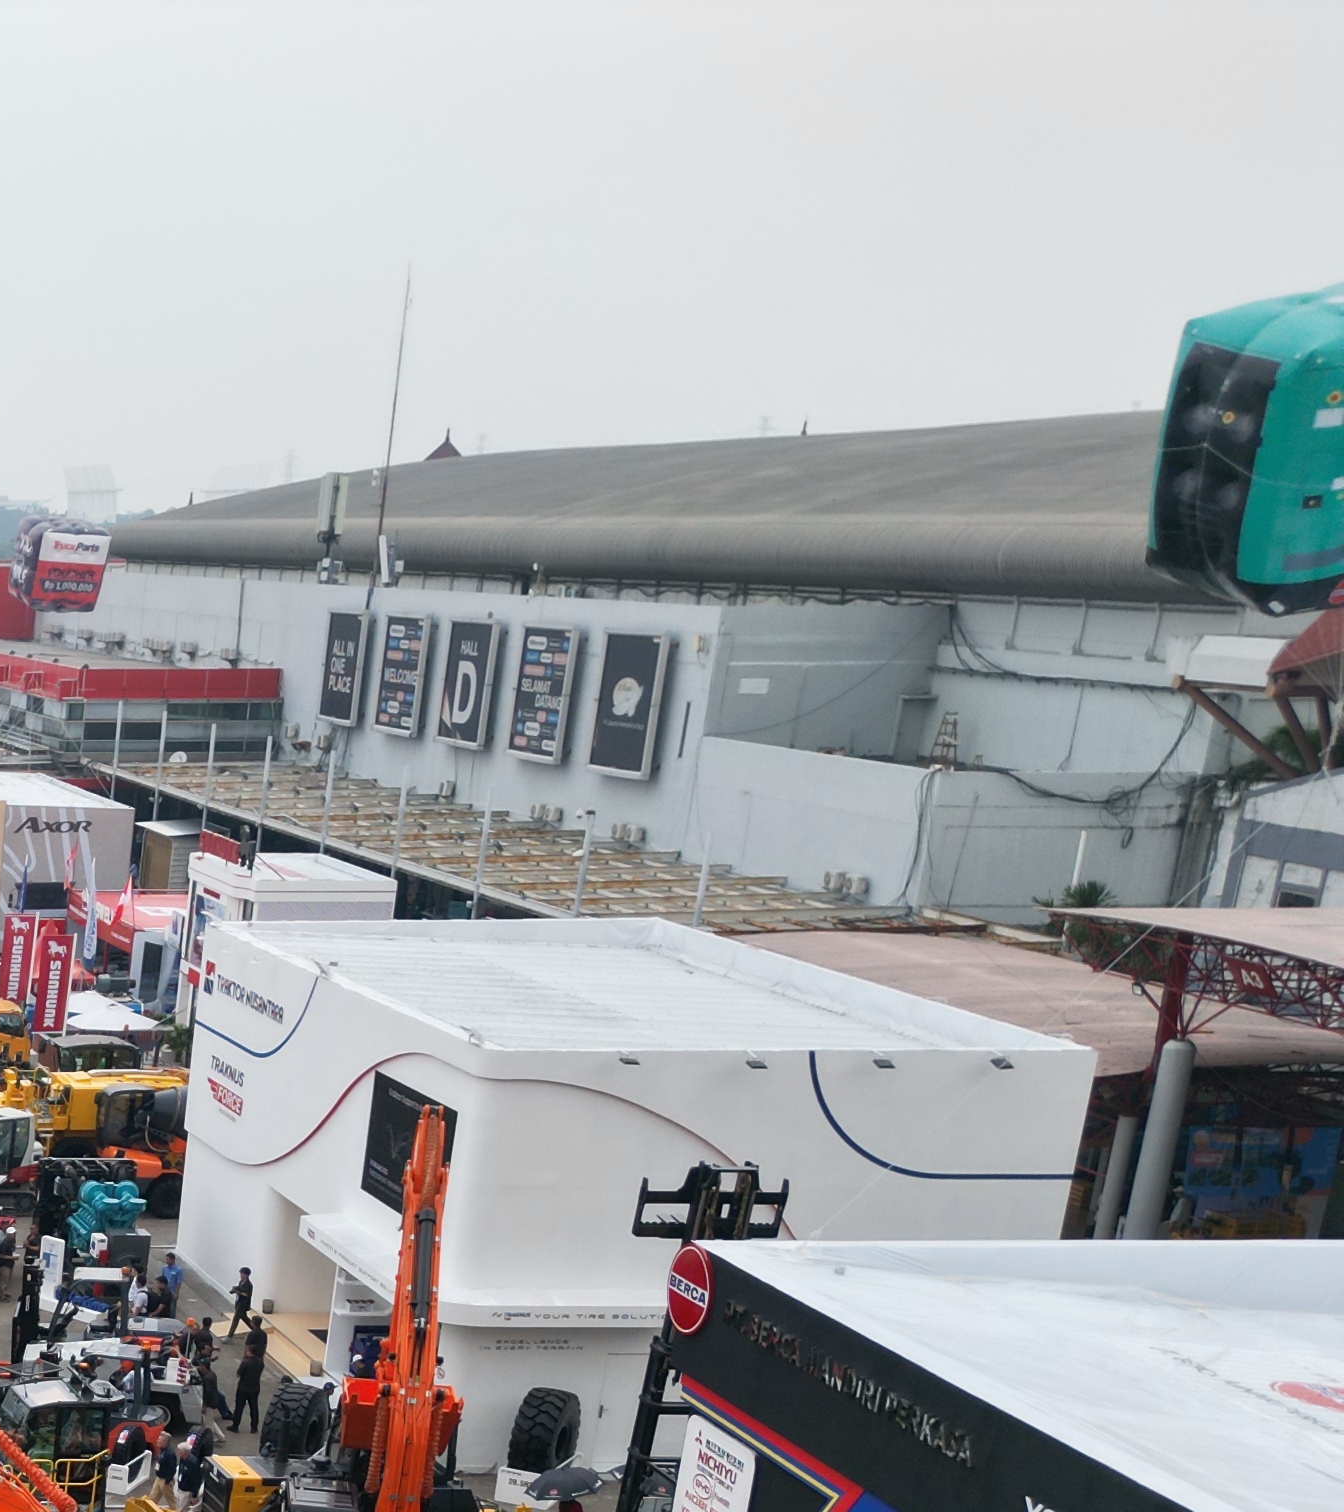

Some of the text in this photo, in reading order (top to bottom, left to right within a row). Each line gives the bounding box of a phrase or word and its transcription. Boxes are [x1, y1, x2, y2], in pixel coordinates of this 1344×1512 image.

[44, 581, 93, 592] Rp 1.000.000
[333, 639, 355, 657] ALL IN
[460, 640, 478, 656] HALL
[330, 656, 345, 673] ONE
[328, 675, 352, 693] PLACE
[452, 660, 477, 724] D
[521, 677, 552, 694] SELAMAT
[43, 960, 61, 1028] SUNHUNK
[217, 973, 246, 1002] TRAKTOR
[211, 1054, 245, 1088] TRAKNUS
[216, 1084, 242, 1116] FORCE
[670, 1273, 707, 1311] BERCA
[698, 1449, 736, 1485] NICHIYU
[696, 1477, 711, 1495] BYD
